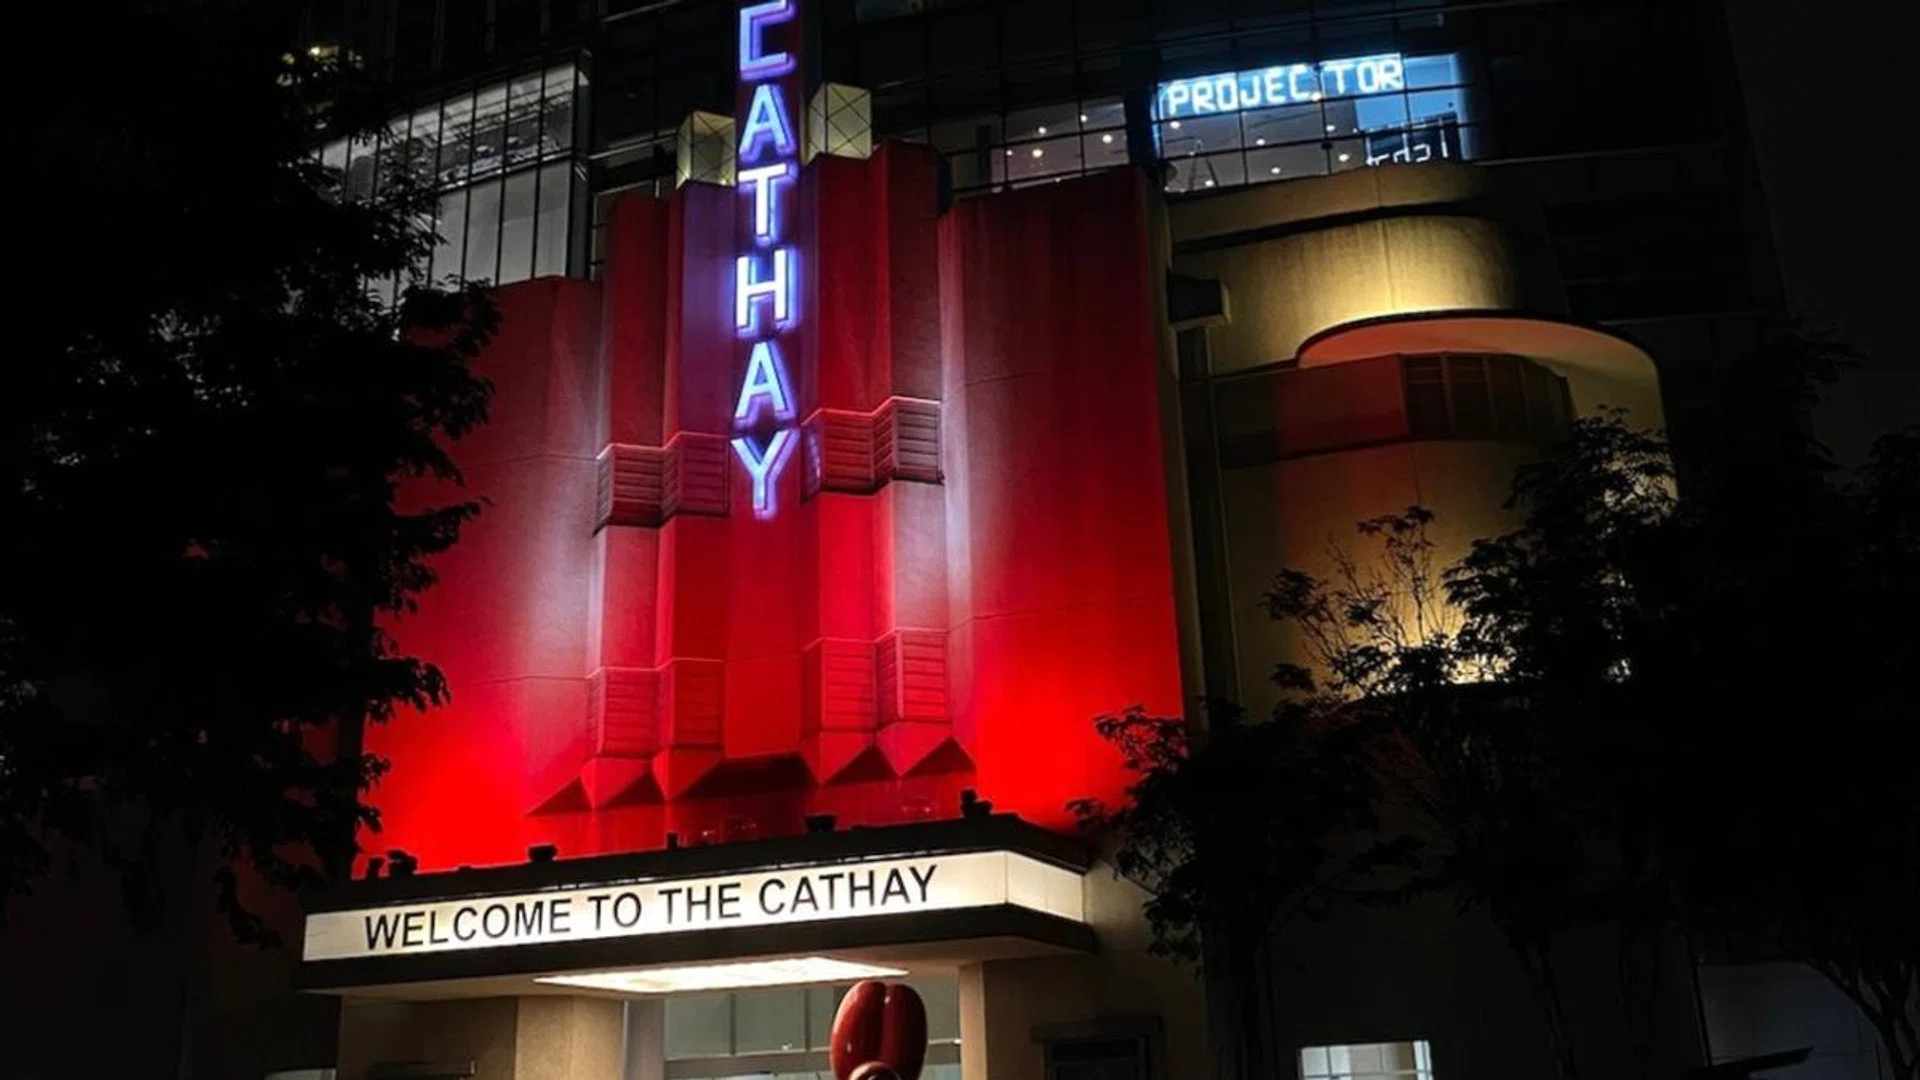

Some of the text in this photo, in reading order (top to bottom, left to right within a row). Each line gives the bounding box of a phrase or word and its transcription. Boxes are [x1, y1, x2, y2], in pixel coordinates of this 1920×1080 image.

[1166, 58, 1405, 116] PROJECTOR
[732, 0, 799, 519] CATHAY
[365, 864, 937, 950] WELCOME TO THE CATHAY
